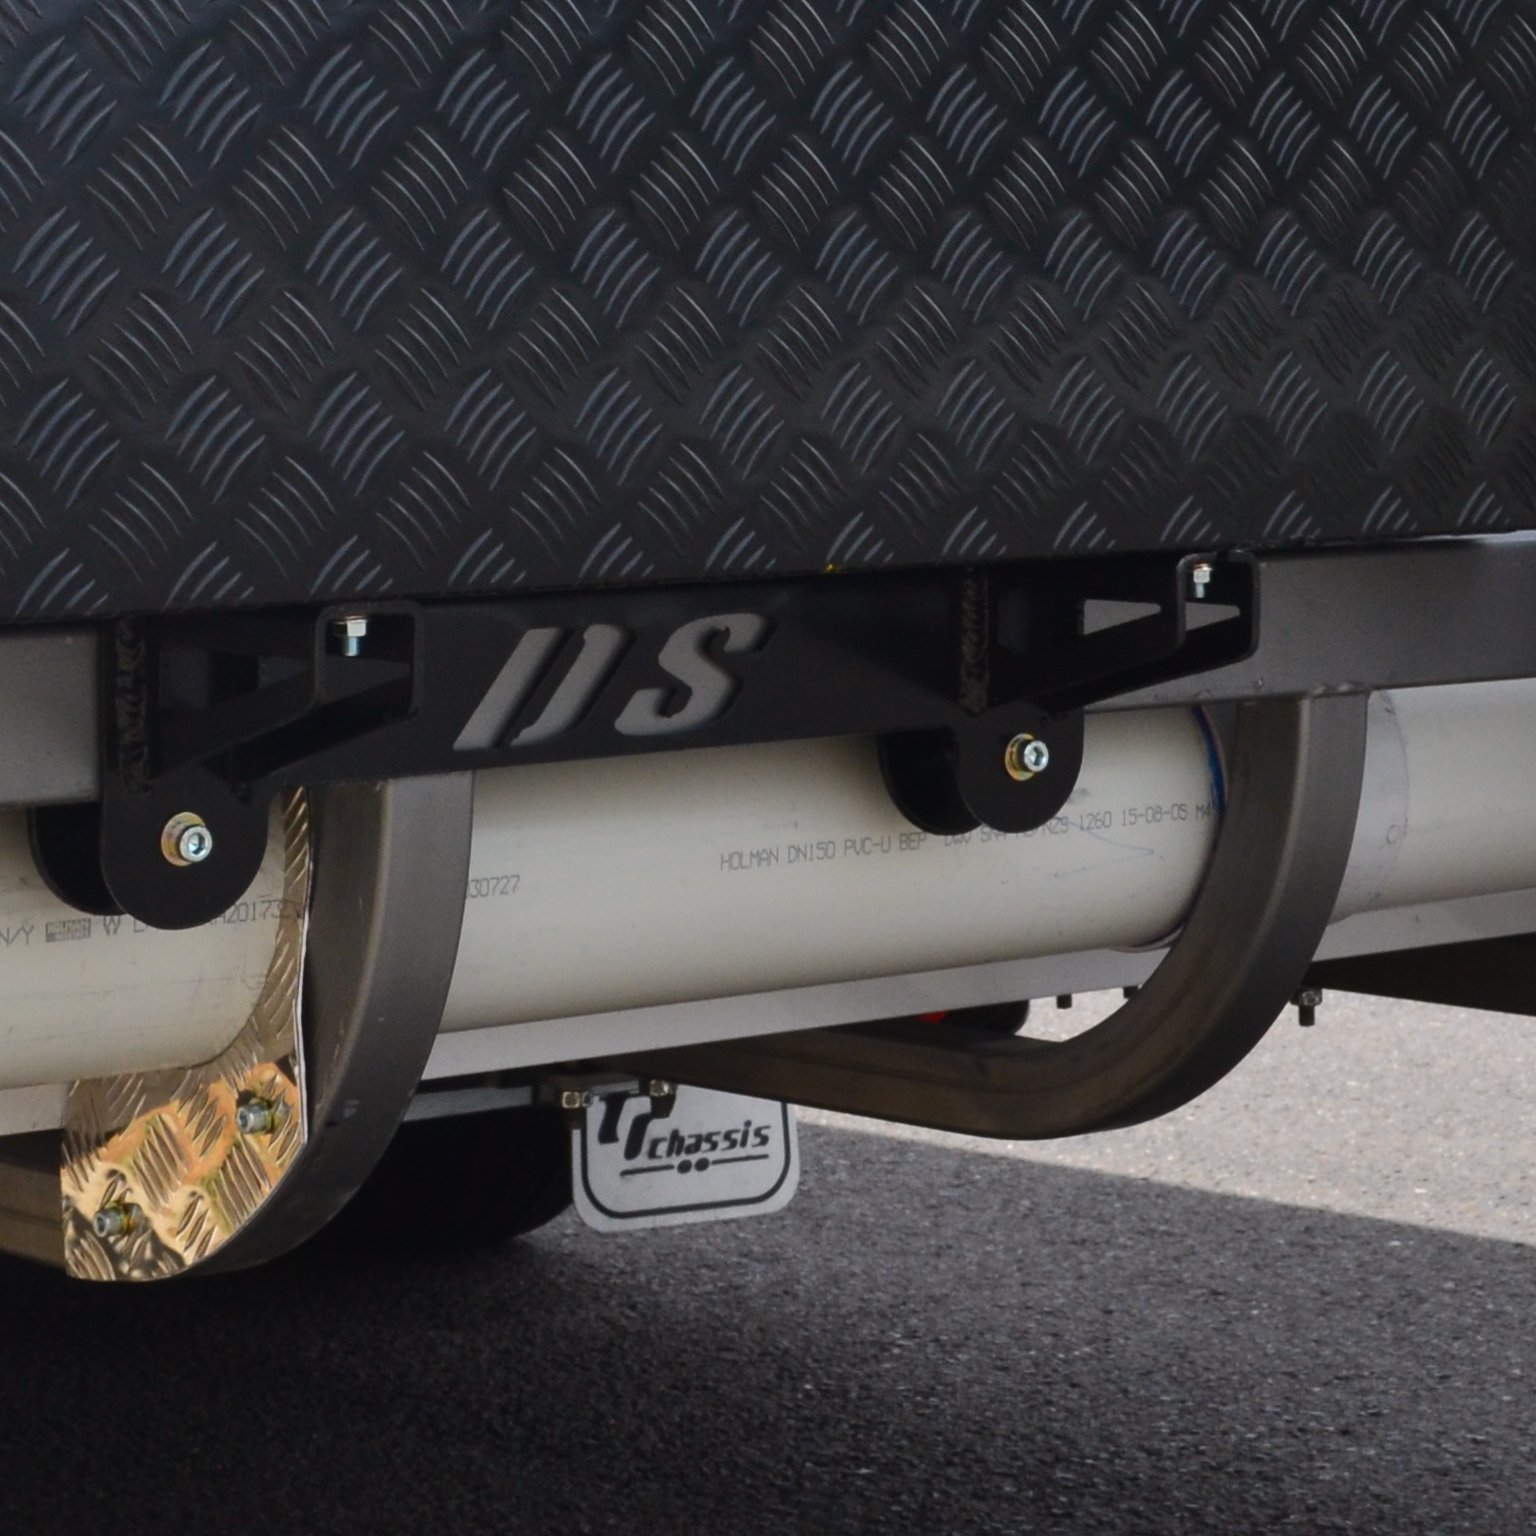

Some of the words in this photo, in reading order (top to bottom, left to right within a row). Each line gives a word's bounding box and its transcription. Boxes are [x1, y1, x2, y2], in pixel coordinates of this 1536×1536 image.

[719, 847, 780, 872] HOLMAN
[843, 834, 892, 858] PVC-U
[1078, 810, 1113, 832] 1260
[465, 874, 521, 899] 30727
[647, 1119, 772, 1160] chassis
